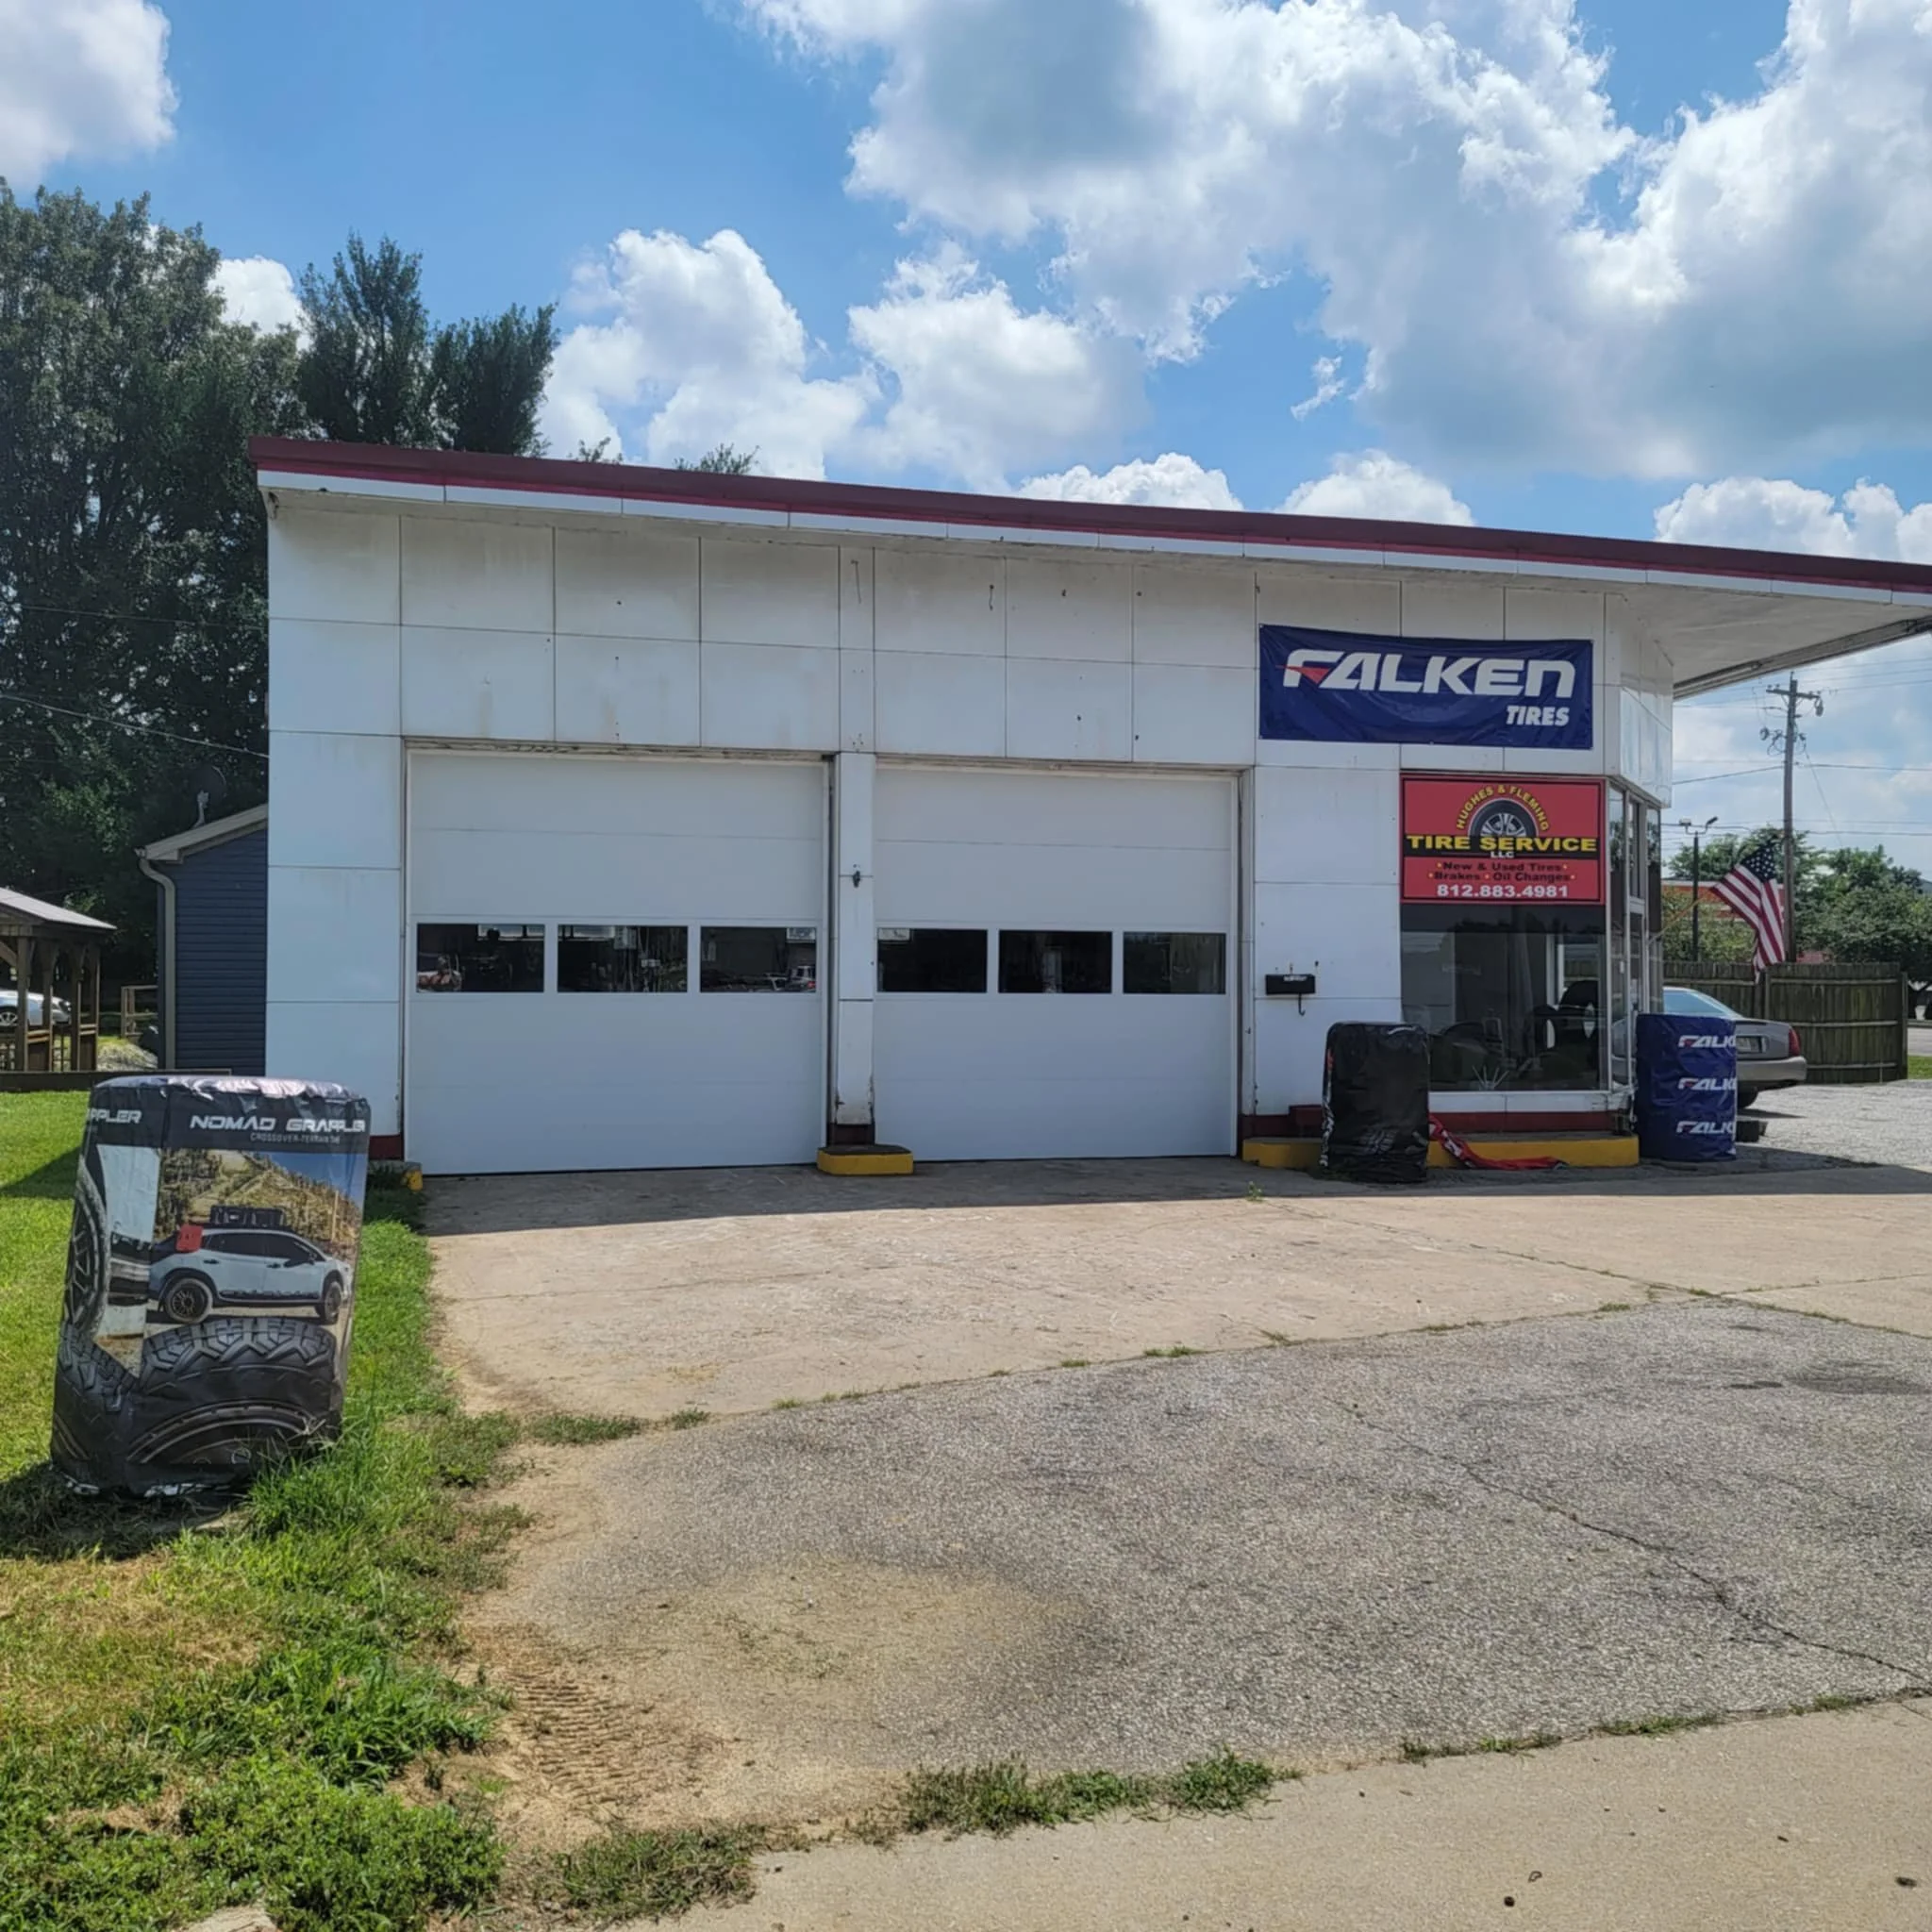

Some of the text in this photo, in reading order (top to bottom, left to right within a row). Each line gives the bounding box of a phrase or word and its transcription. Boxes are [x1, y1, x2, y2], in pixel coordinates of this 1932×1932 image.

[1282, 648, 1576, 698] FALKEN
[1506, 706, 1570, 726] TIRES
[1456, 785, 1549, 831] HUGHES & FLEMING
[1407, 835, 1597, 852] TIRE SERVICE
[1477, 862, 1487, 871] &
[1492, 863, 1524, 872] Used
[1530, 863, 1562, 872] Tires
[1515, 873, 1570, 882] Changes
[1437, 884, 1569, 898] 812.883.4981
[190, 1115, 276, 1130] NOMAD
